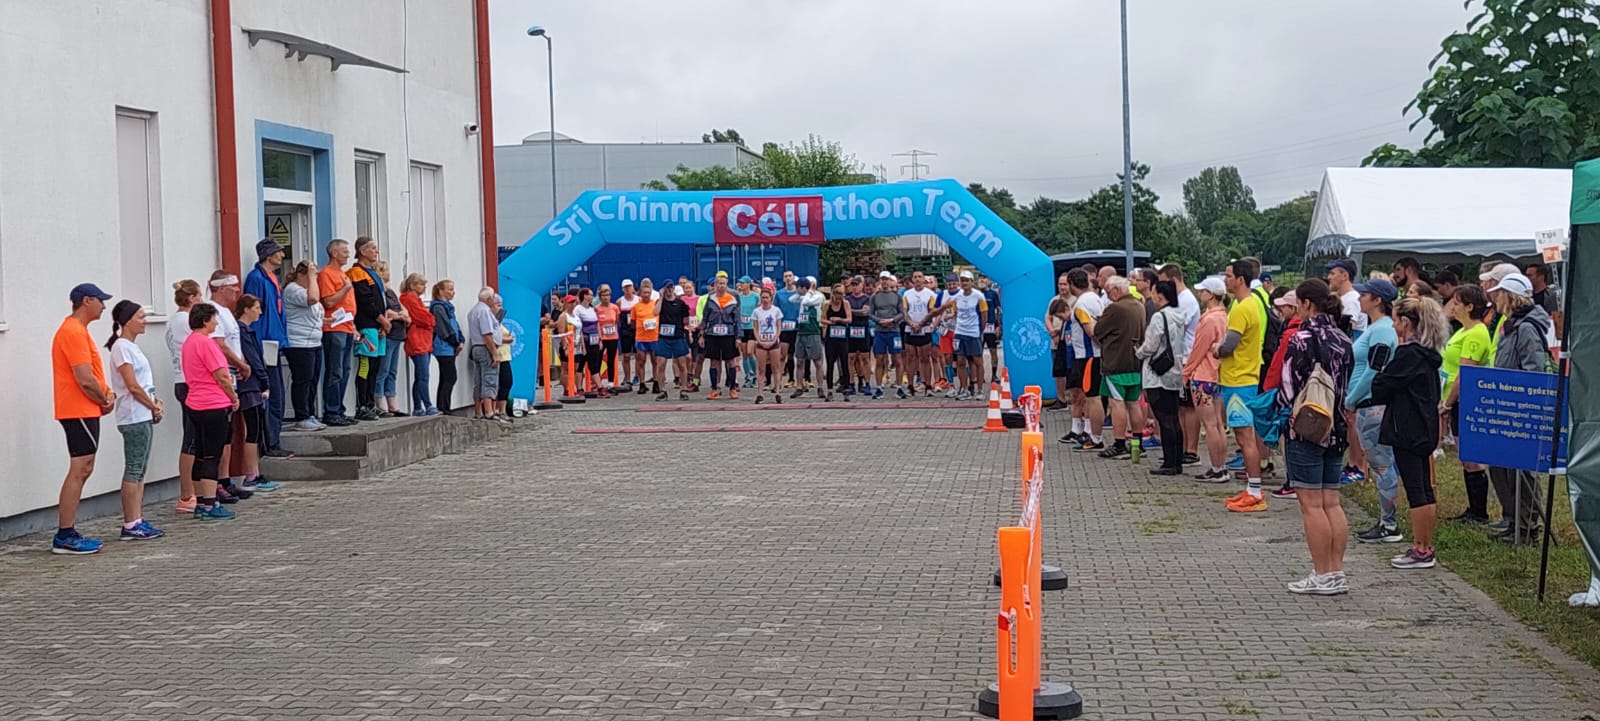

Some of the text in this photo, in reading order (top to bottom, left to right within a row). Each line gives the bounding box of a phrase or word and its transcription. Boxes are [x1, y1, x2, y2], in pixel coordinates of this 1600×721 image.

[548, 188, 1003, 258] Sri Chinmo athon Team
[727, 203, 810, 237] Cél!
[1478, 380, 1496, 389] Csak
[1499, 382, 1525, 392] három
